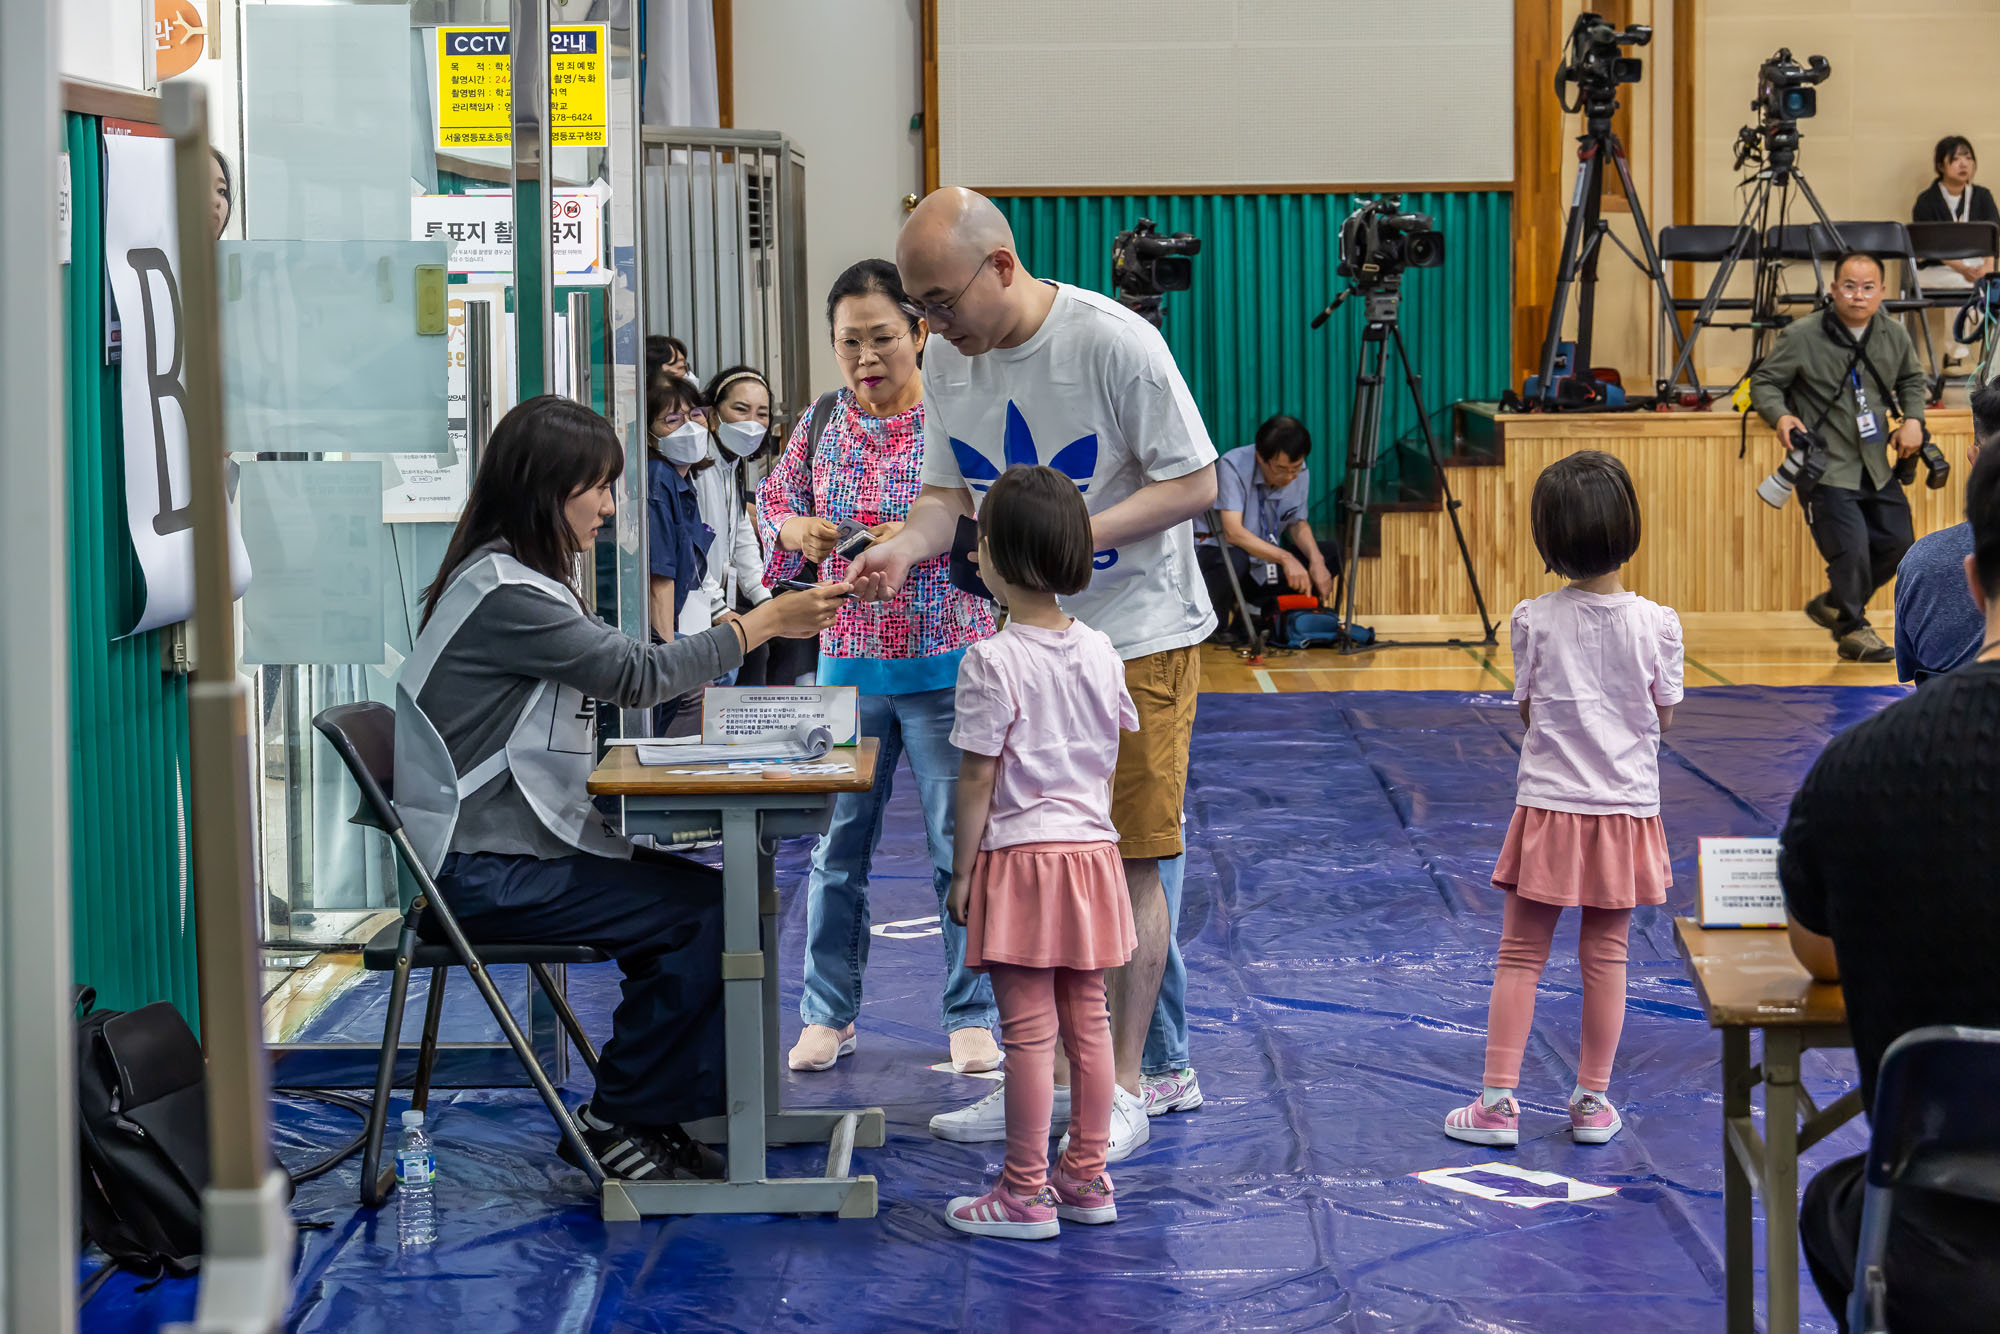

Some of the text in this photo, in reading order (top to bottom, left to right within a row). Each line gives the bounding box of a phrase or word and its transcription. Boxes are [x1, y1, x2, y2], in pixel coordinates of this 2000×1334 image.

[454, 34, 586, 52] CCTV 안내
[556, 61, 596, 71] 범죄예방
[451, 75, 485, 84] 촬영시간
[554, 74, 596, 84] 촬영/녹화
[451, 88, 485, 98] 촬영범위
[452, 102, 494, 112] 관리책임자
[552, 131, 602, 141] 영등포구청장
[425, 221, 486, 244] 투표지
